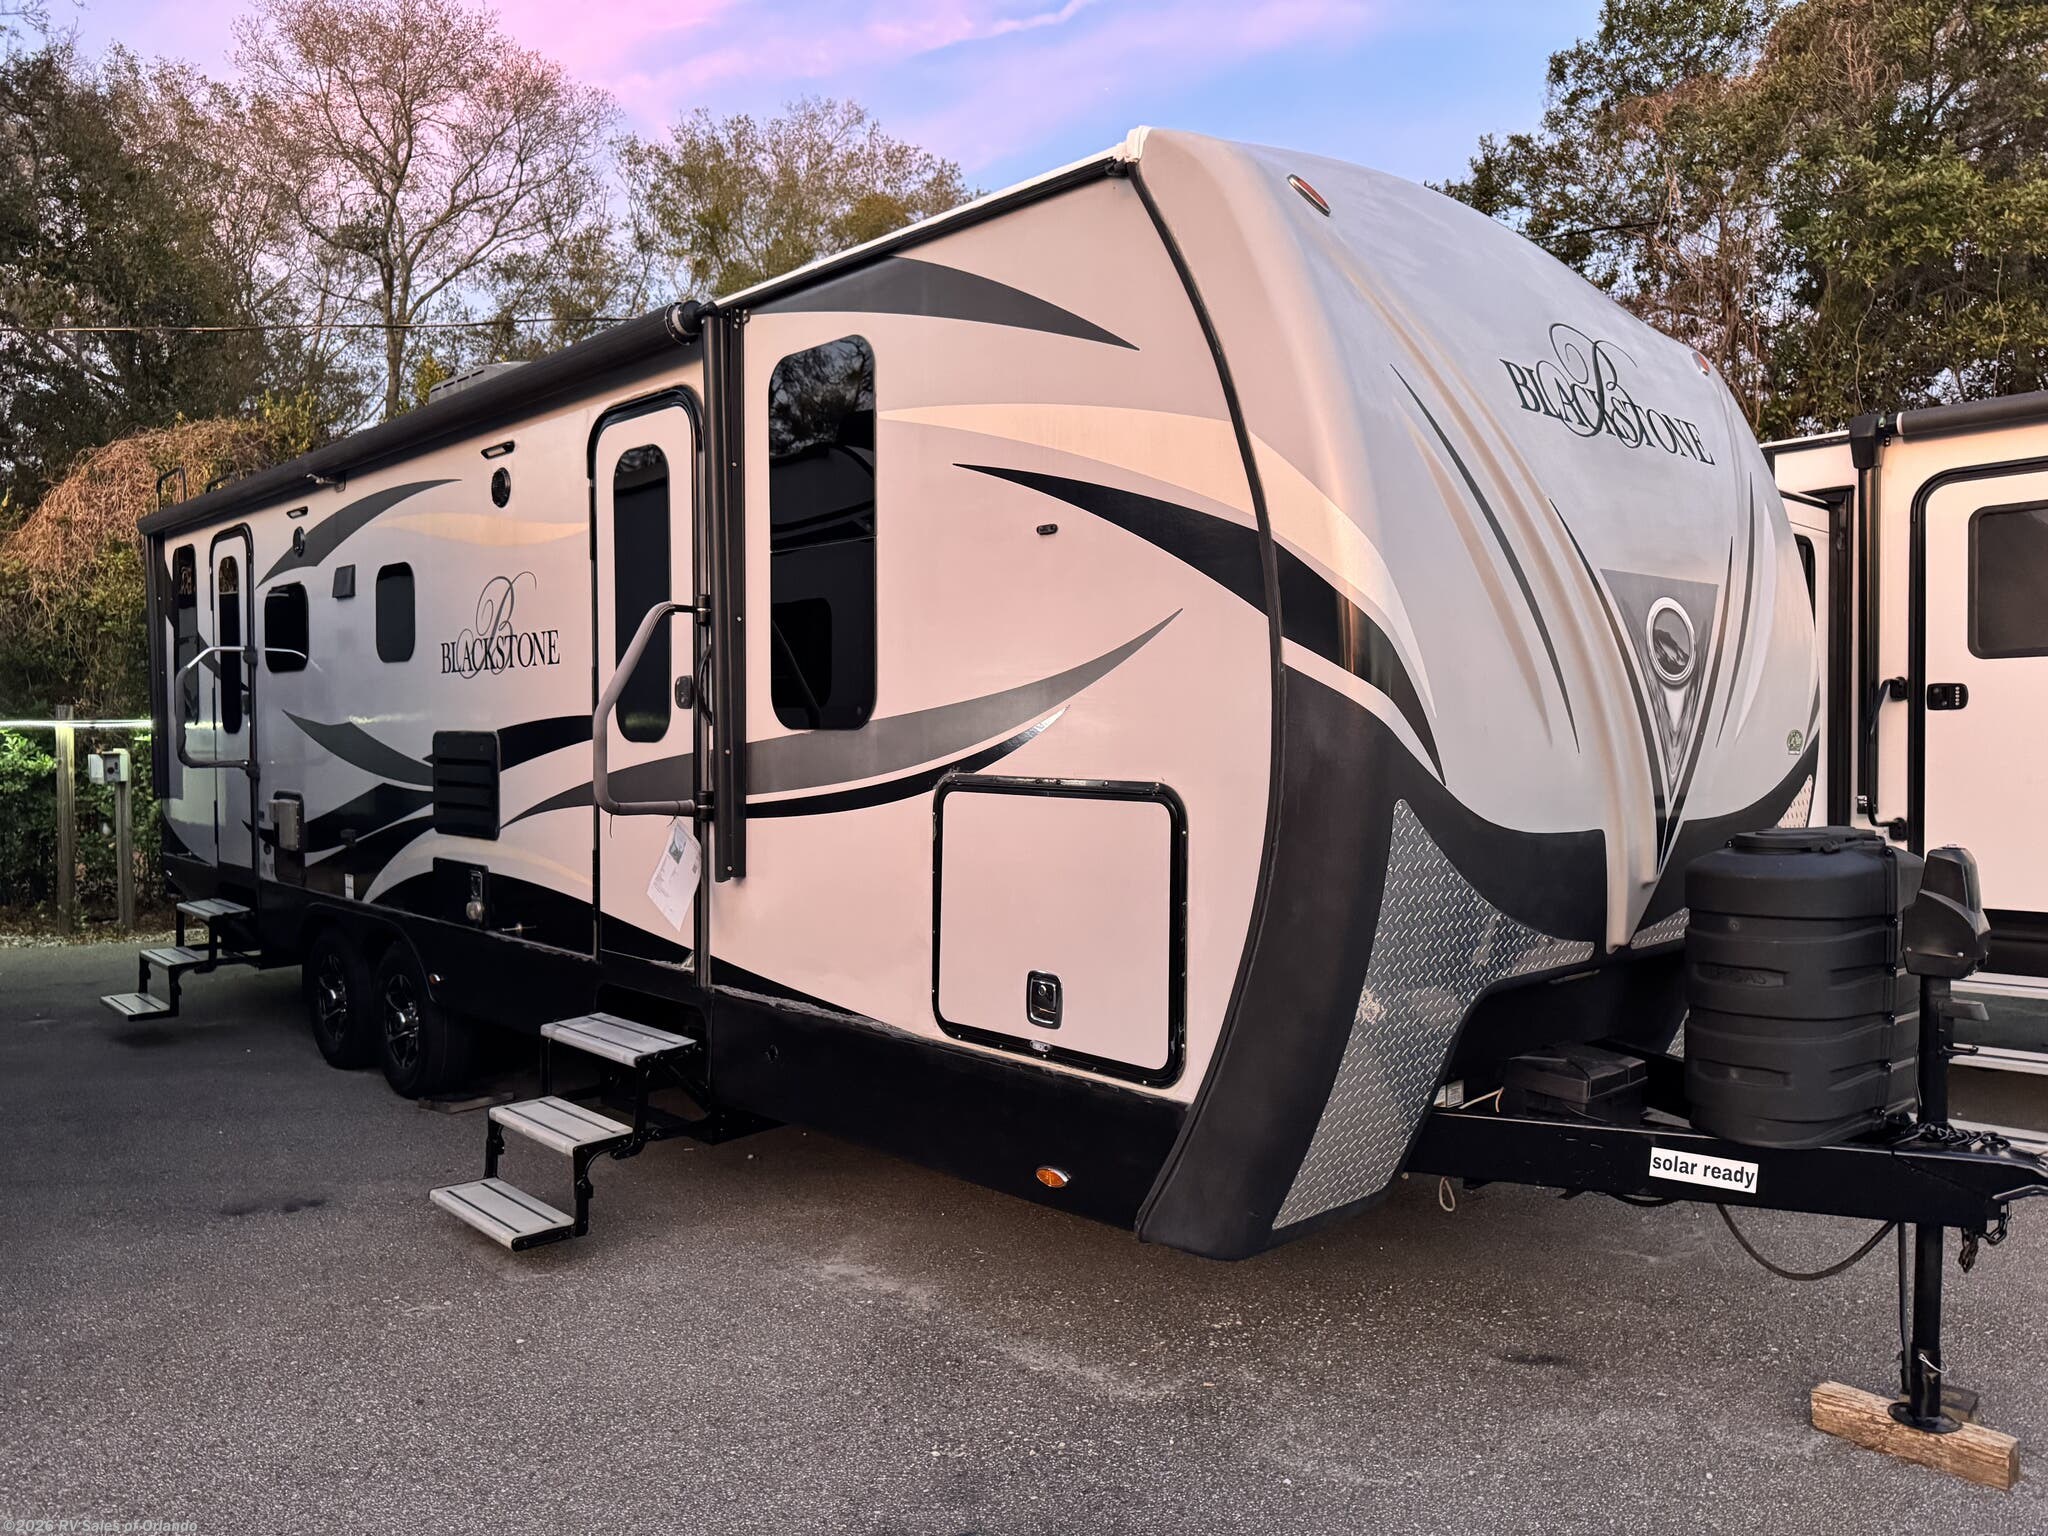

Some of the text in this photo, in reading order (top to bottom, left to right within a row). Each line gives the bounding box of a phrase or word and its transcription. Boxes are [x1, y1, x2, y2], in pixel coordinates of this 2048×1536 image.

[1499, 358, 1716, 466] BLACKSTONE
[440, 630, 561, 674] BLACKSTONE
[1652, 1155, 1756, 1189] solar ready
